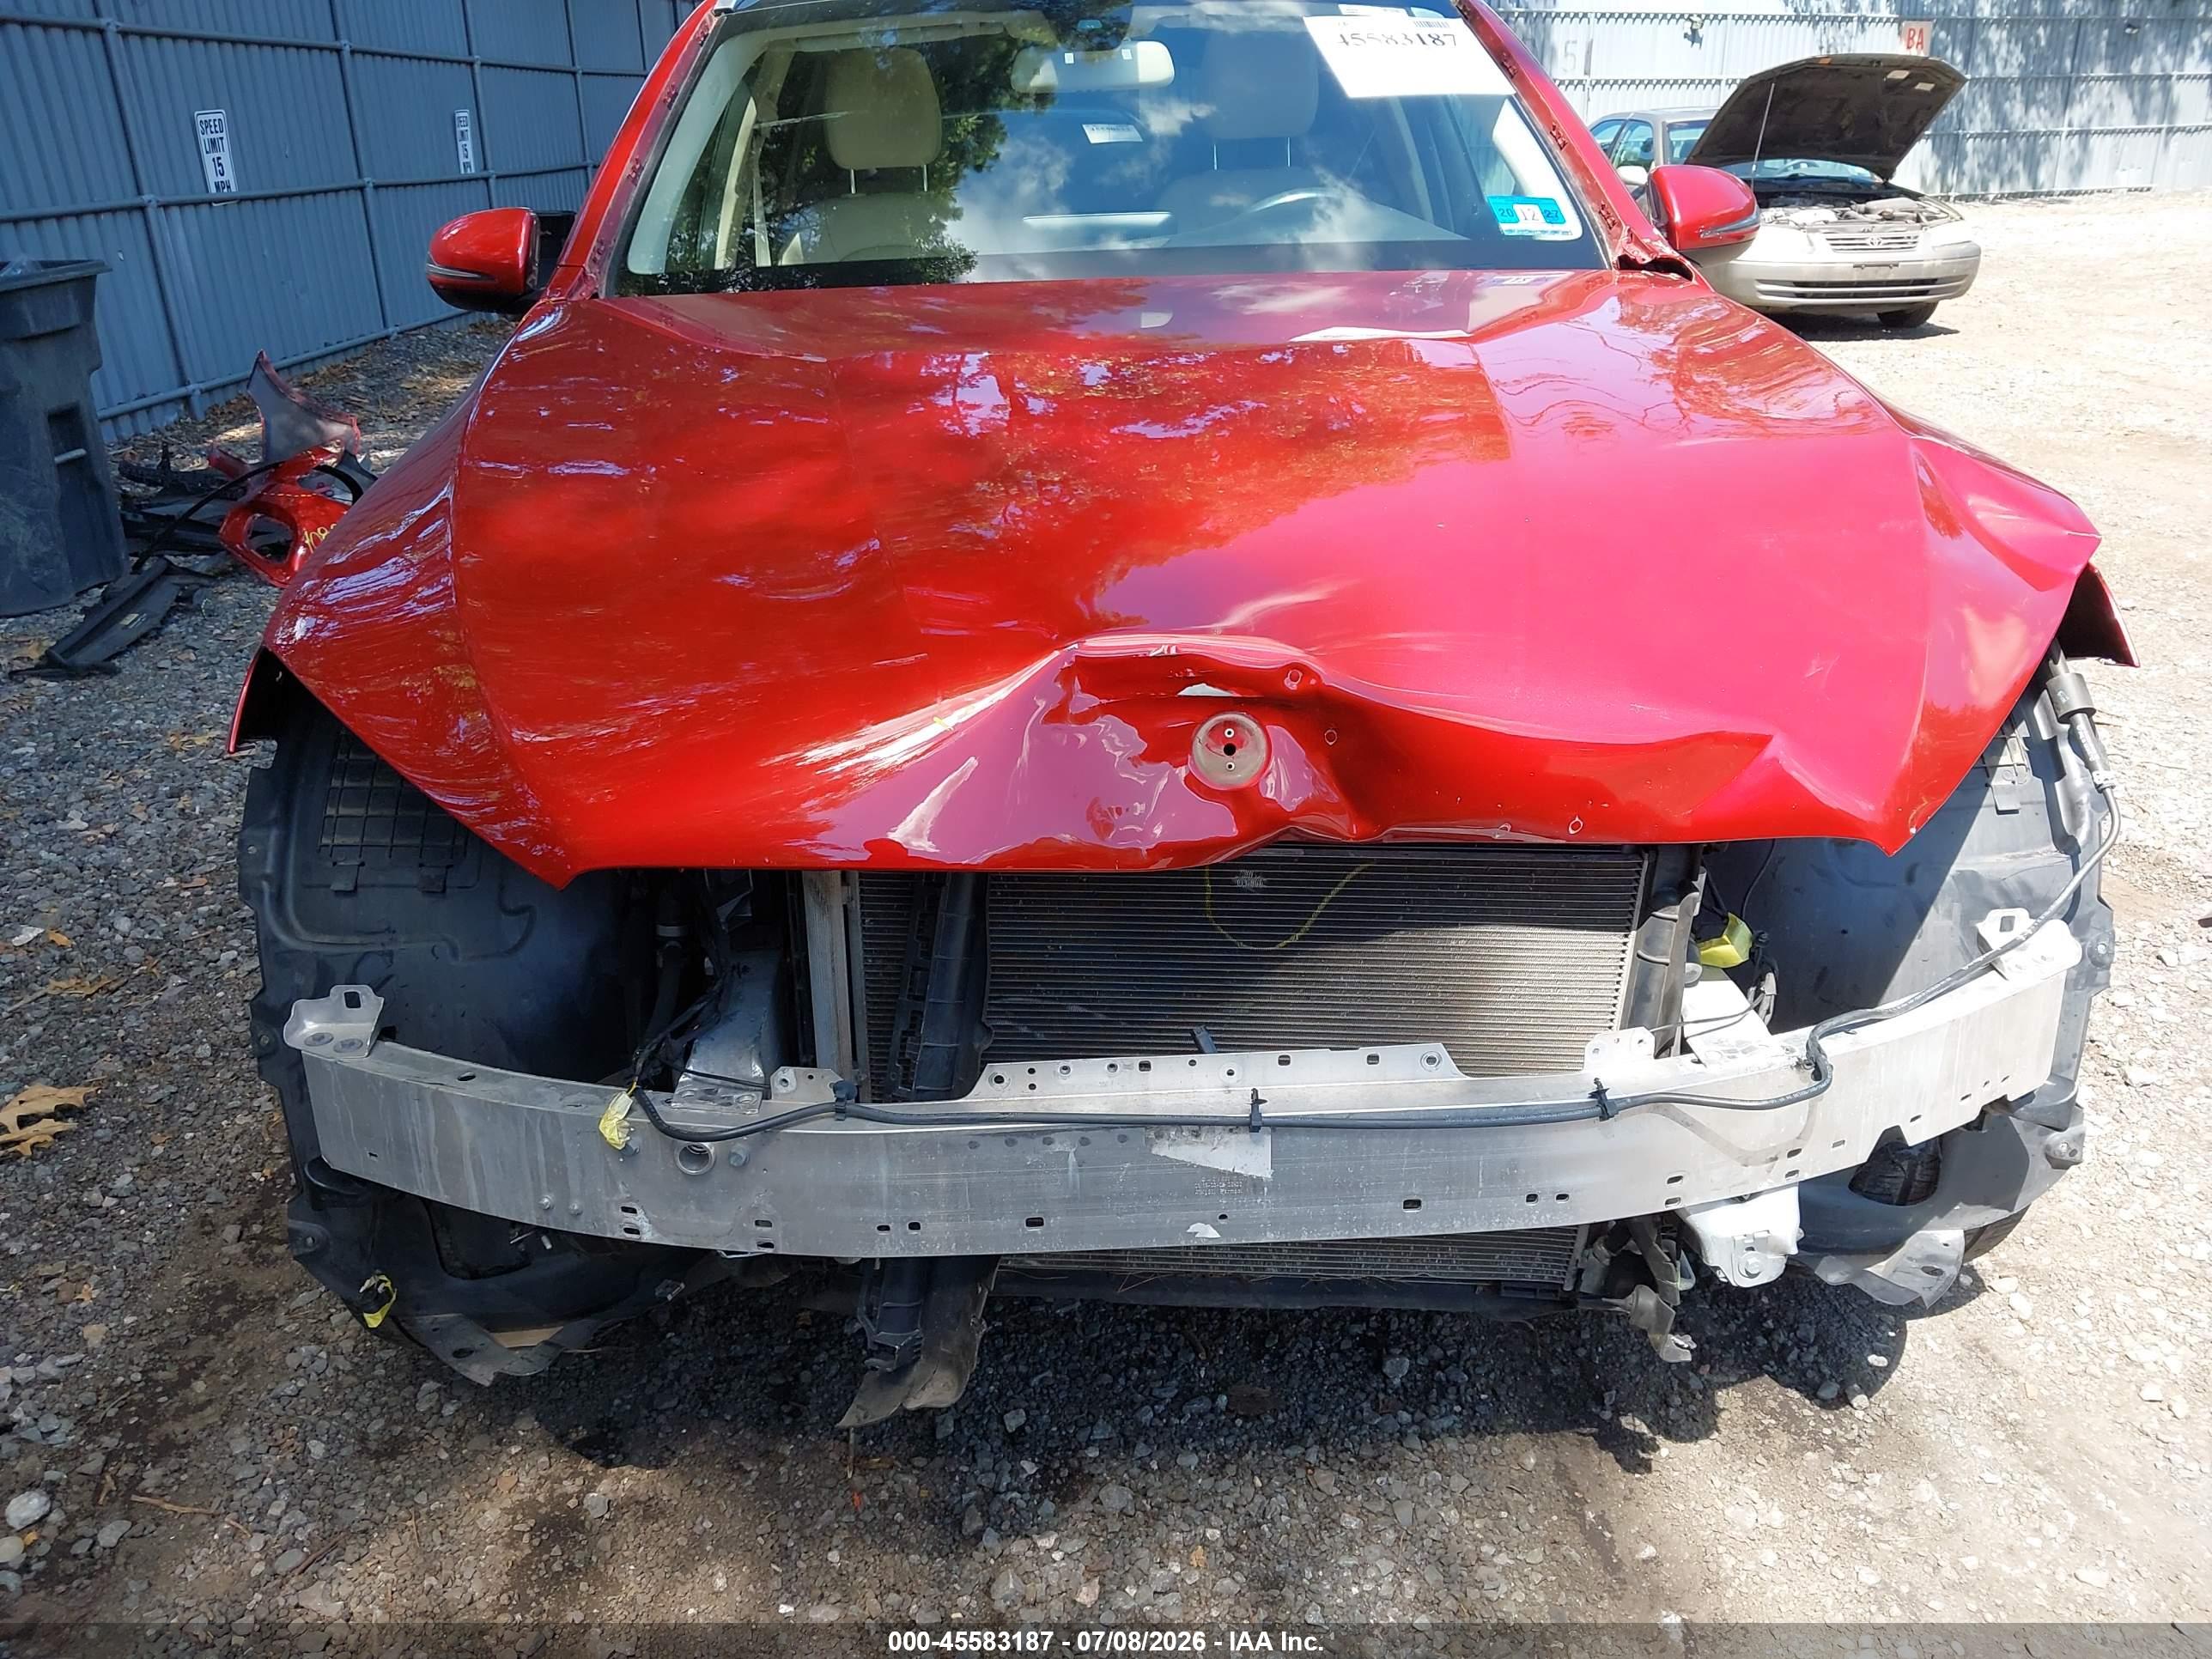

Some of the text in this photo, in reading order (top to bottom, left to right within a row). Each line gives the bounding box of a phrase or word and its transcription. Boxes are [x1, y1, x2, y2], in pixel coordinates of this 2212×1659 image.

[199, 118, 224, 136] SPEED
[204, 137, 225, 155] LIMIT
[212, 156, 225, 177] 15
[214, 179, 232, 192] MPH
[1498, 208, 1515, 218] 20
[1520, 208, 1540, 221] 12
[1543, 210, 1559, 218] 27
